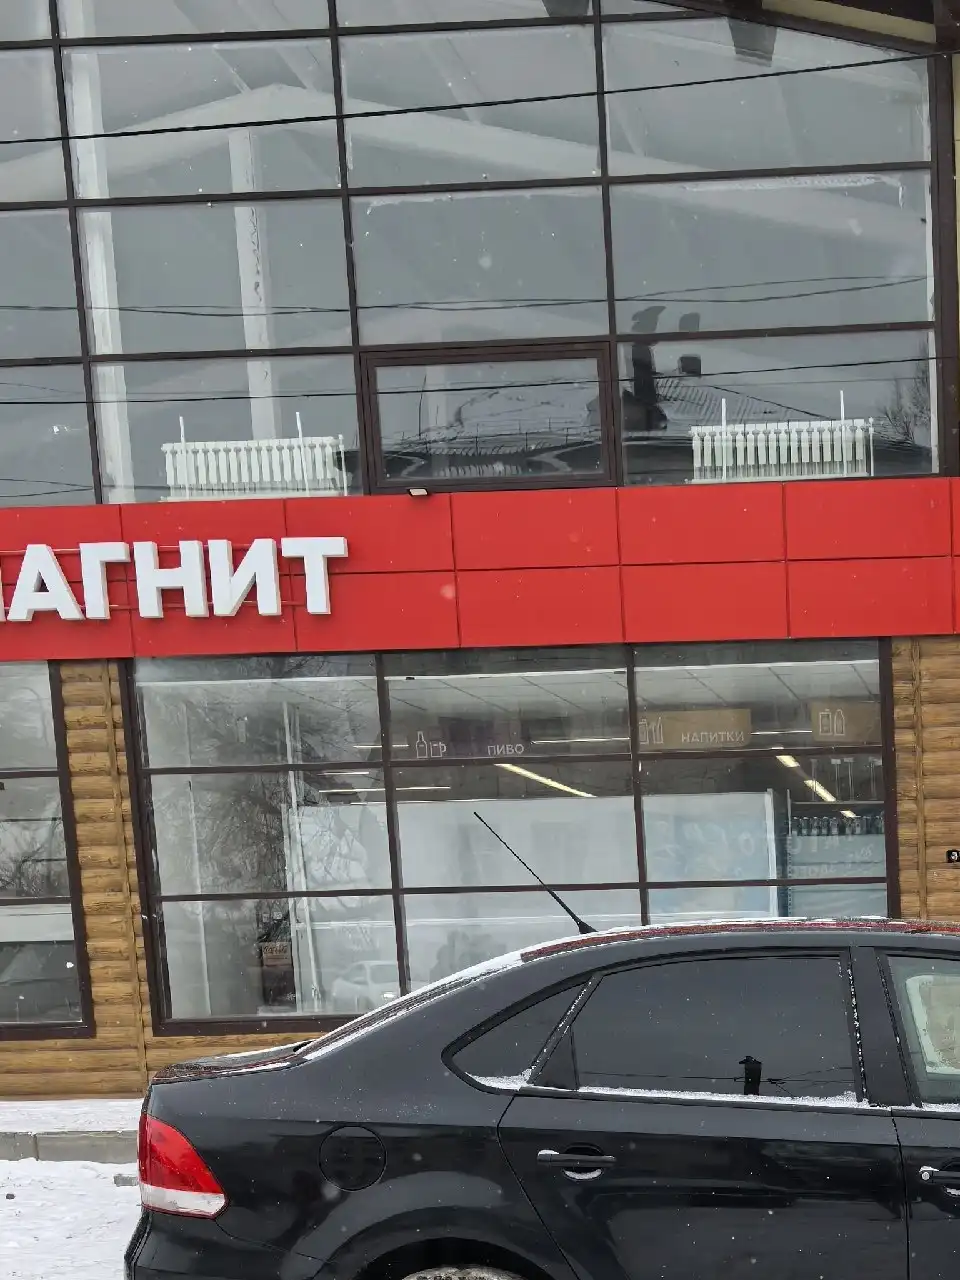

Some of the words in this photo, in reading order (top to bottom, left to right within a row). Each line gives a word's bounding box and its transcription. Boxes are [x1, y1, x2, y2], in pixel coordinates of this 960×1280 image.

[0, 537, 348, 622] АГНИТ
[681, 730, 745, 743] НАПИТКИ
[487, 743, 525, 756] ПИВО
